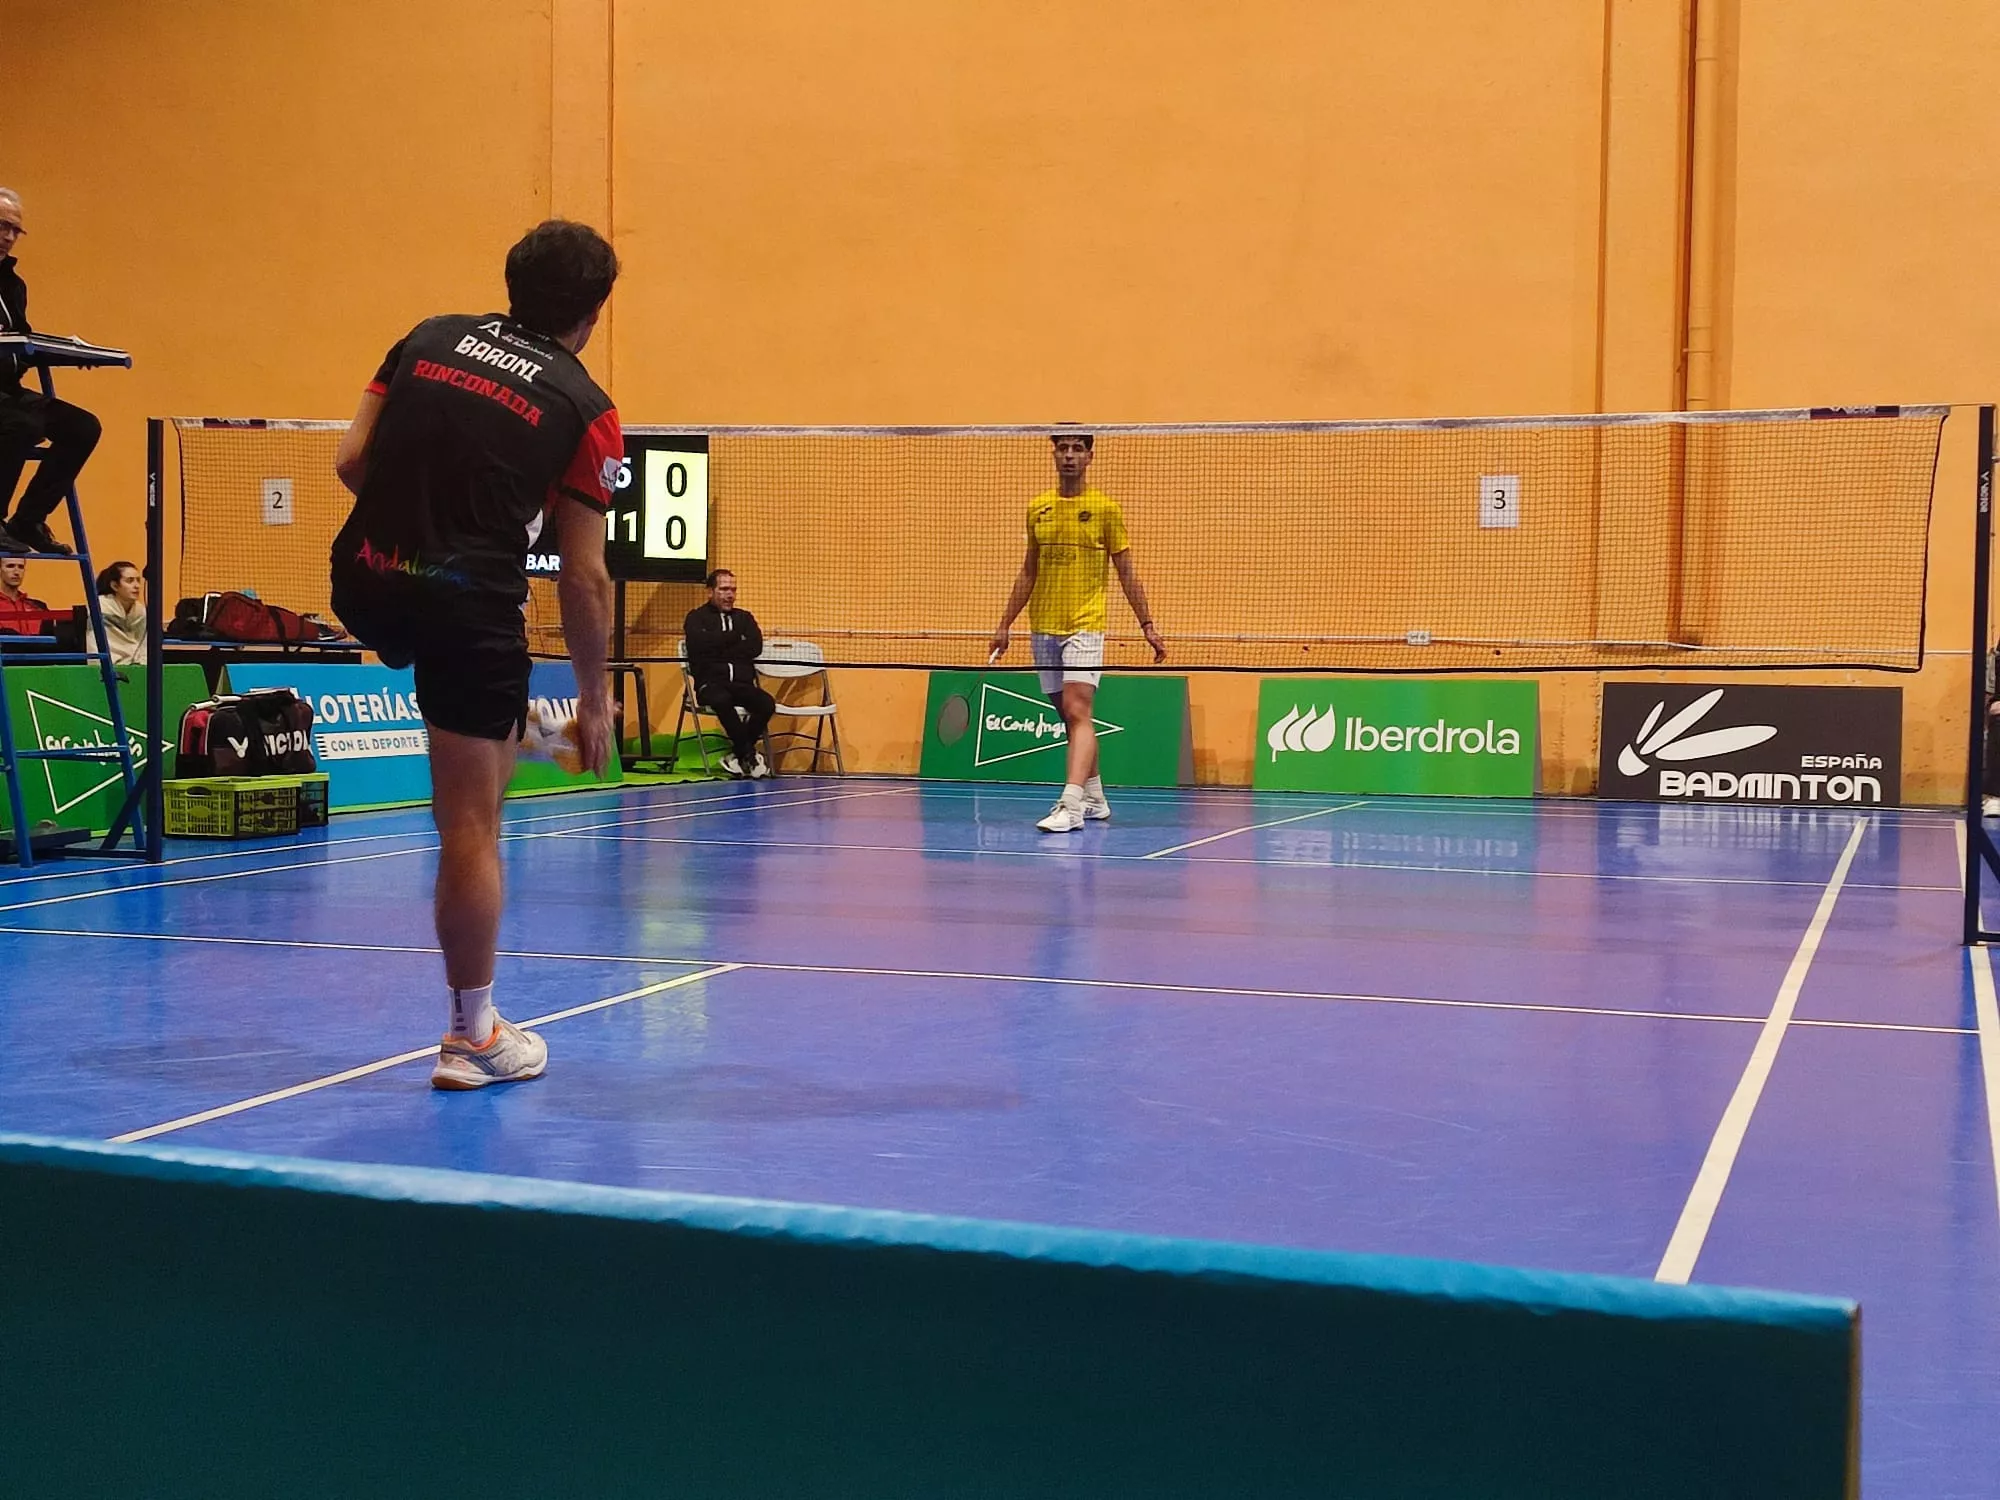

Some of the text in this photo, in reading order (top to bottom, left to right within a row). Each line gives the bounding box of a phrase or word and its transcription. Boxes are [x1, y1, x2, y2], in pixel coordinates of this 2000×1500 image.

[454, 334, 544, 383] BARONI
[413, 359, 544, 427] RINCONADA
[666, 463, 687, 497] 0
[271, 491, 284, 509] 2
[1493, 489, 1506, 510] 3
[605, 509, 687, 550] 11 0
[305, 686, 423, 725] LOTERÍAS
[330, 736, 420, 752] CON EL DEPORTE
[1344, 716, 1520, 755] Iberdrola
[1801, 753, 1883, 770] ESPAÑA
[1659, 770, 1882, 802] BADMINTON
